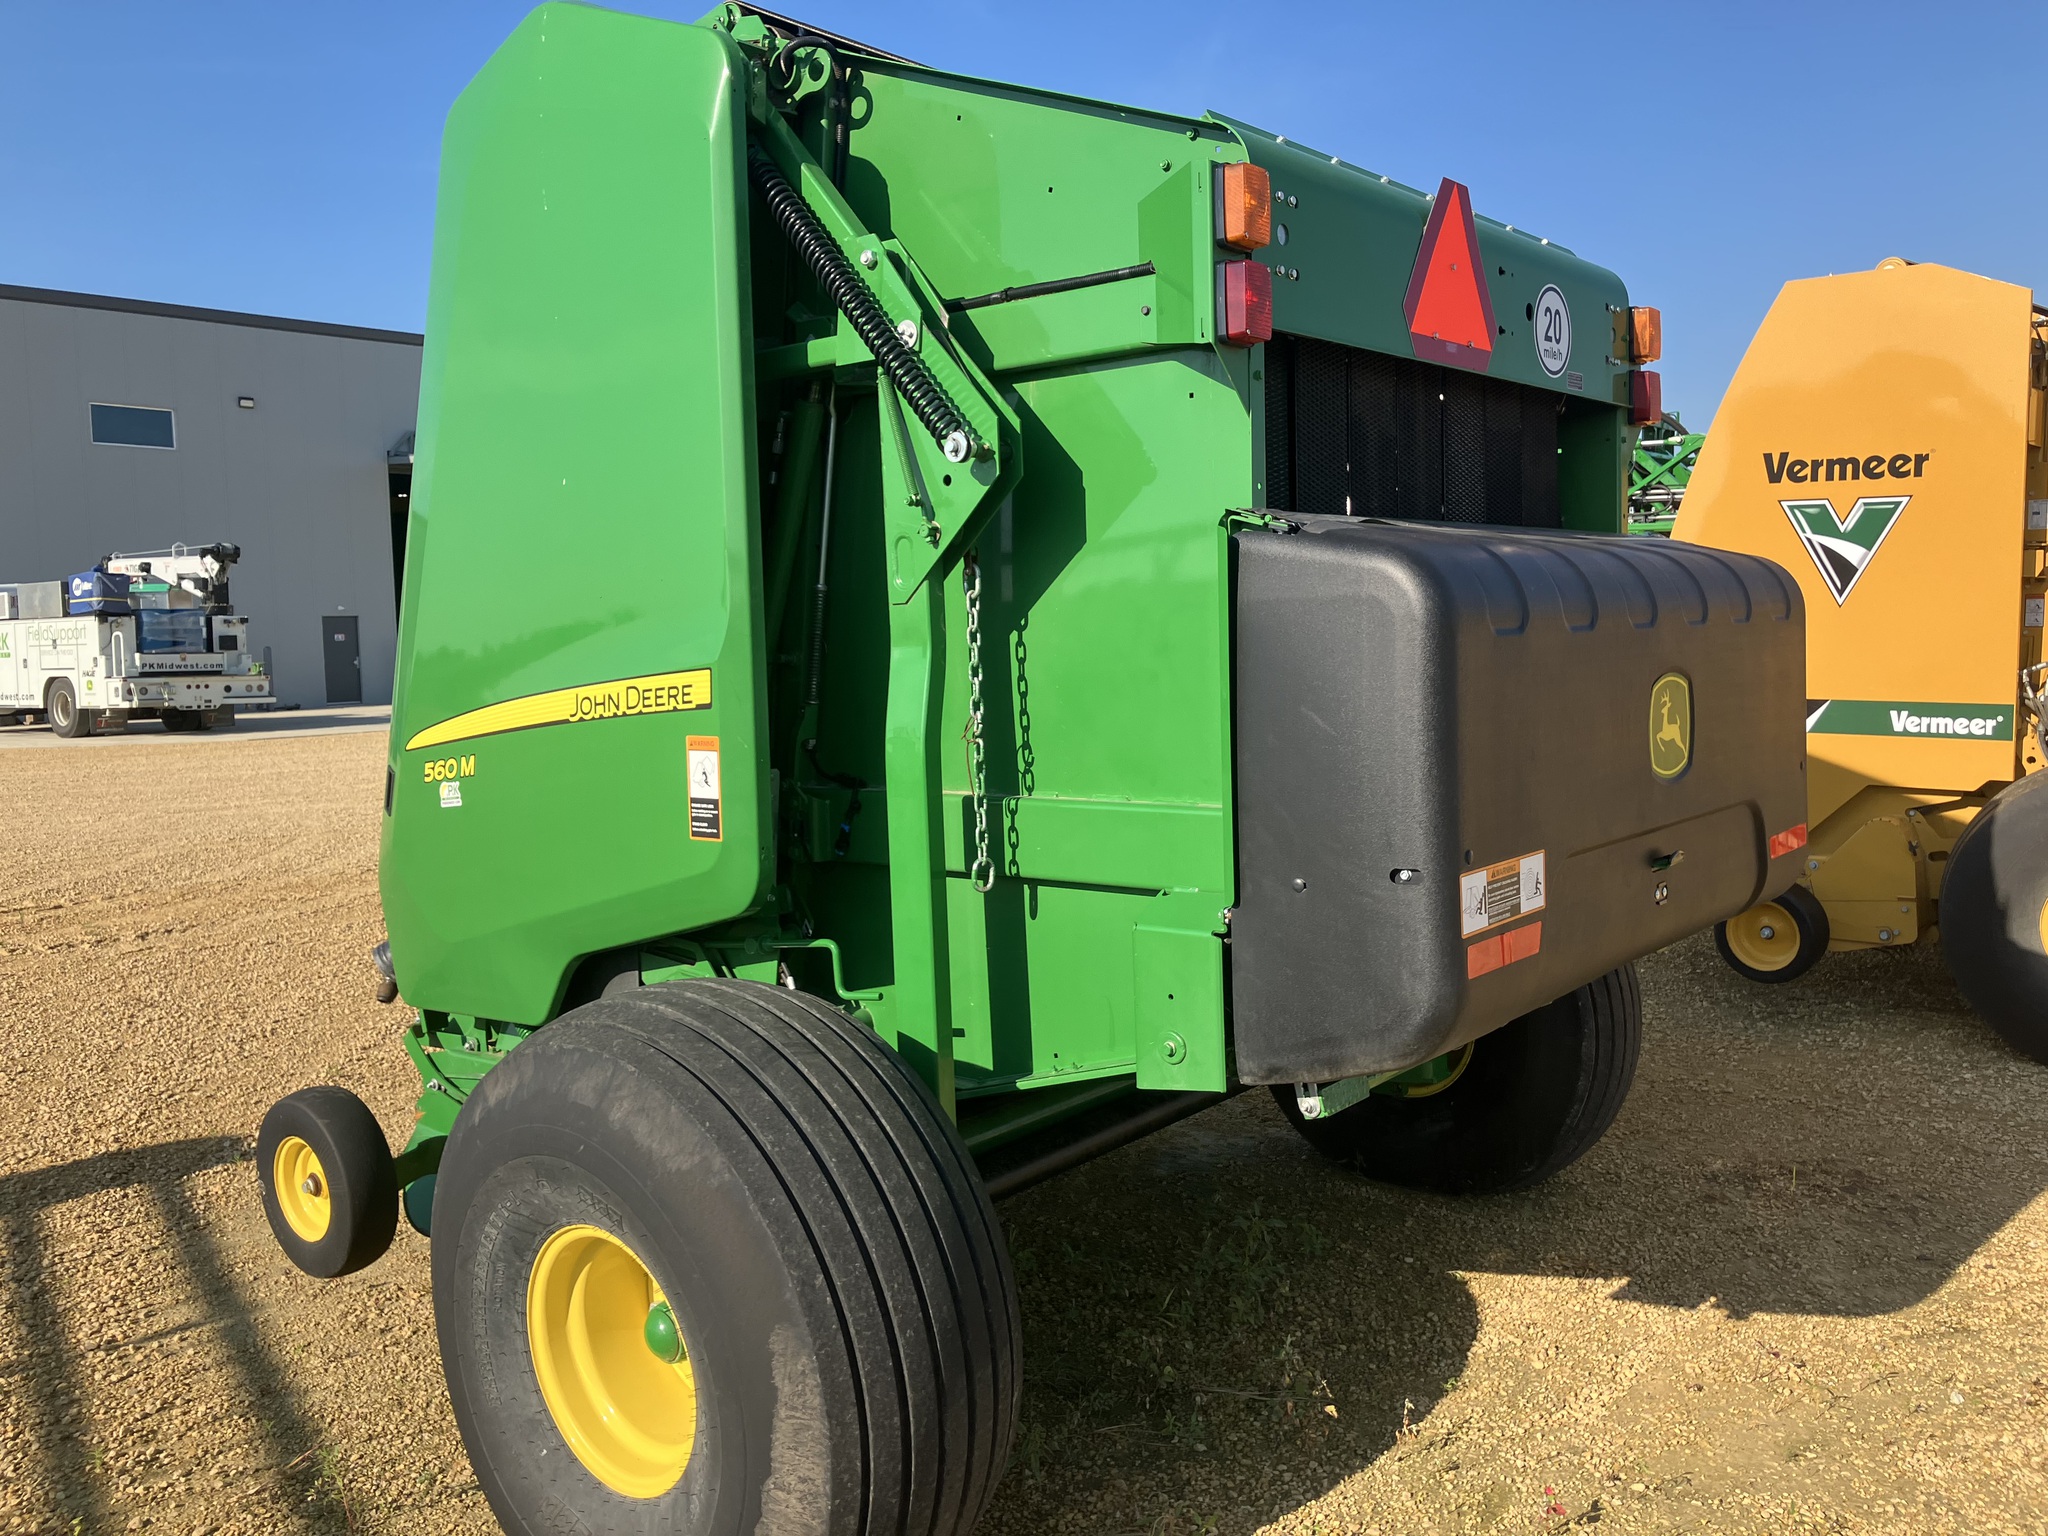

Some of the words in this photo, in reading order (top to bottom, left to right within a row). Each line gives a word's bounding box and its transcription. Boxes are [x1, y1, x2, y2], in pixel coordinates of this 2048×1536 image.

[1544, 306, 1562, 345] 20
[1543, 347, 1563, 361] mile/h
[1762, 451, 1930, 484] Vermeer
[141, 662, 223, 670] PKMidwest.com
[569, 691, 620, 718] JOHN
[625, 683, 693, 711] DEERE
[1889, 709, 1997, 736] Vermeer
[425, 757, 458, 784] 560
[461, 754, 476, 778] M
